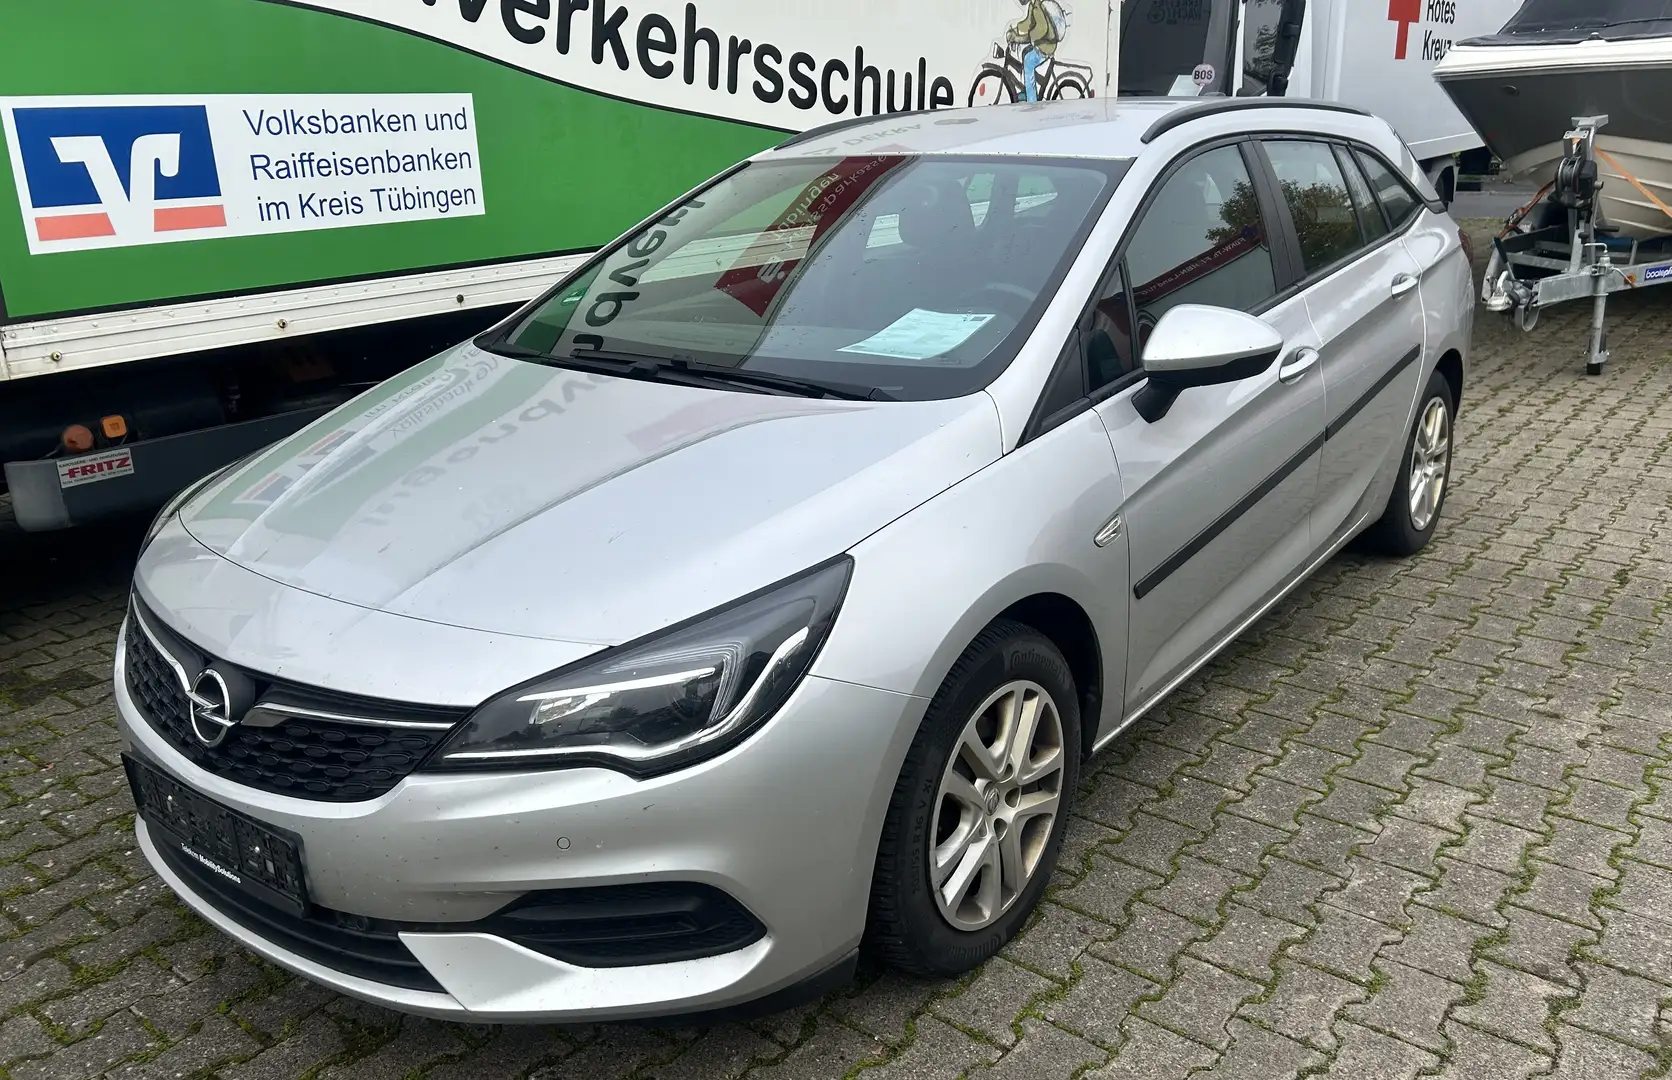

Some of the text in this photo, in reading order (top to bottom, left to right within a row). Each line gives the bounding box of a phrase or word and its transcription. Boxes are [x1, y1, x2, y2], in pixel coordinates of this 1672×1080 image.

[1425, 0, 1456, 24] Rotes
[1193, 69, 1213, 81] BOS
[242, 107, 468, 136] Volksbanken und
[250, 147, 472, 181] Raiffeisenbanken
[257, 186, 477, 222] im Kreis Tübingen
[61, 457, 131, 478] FRITZ
